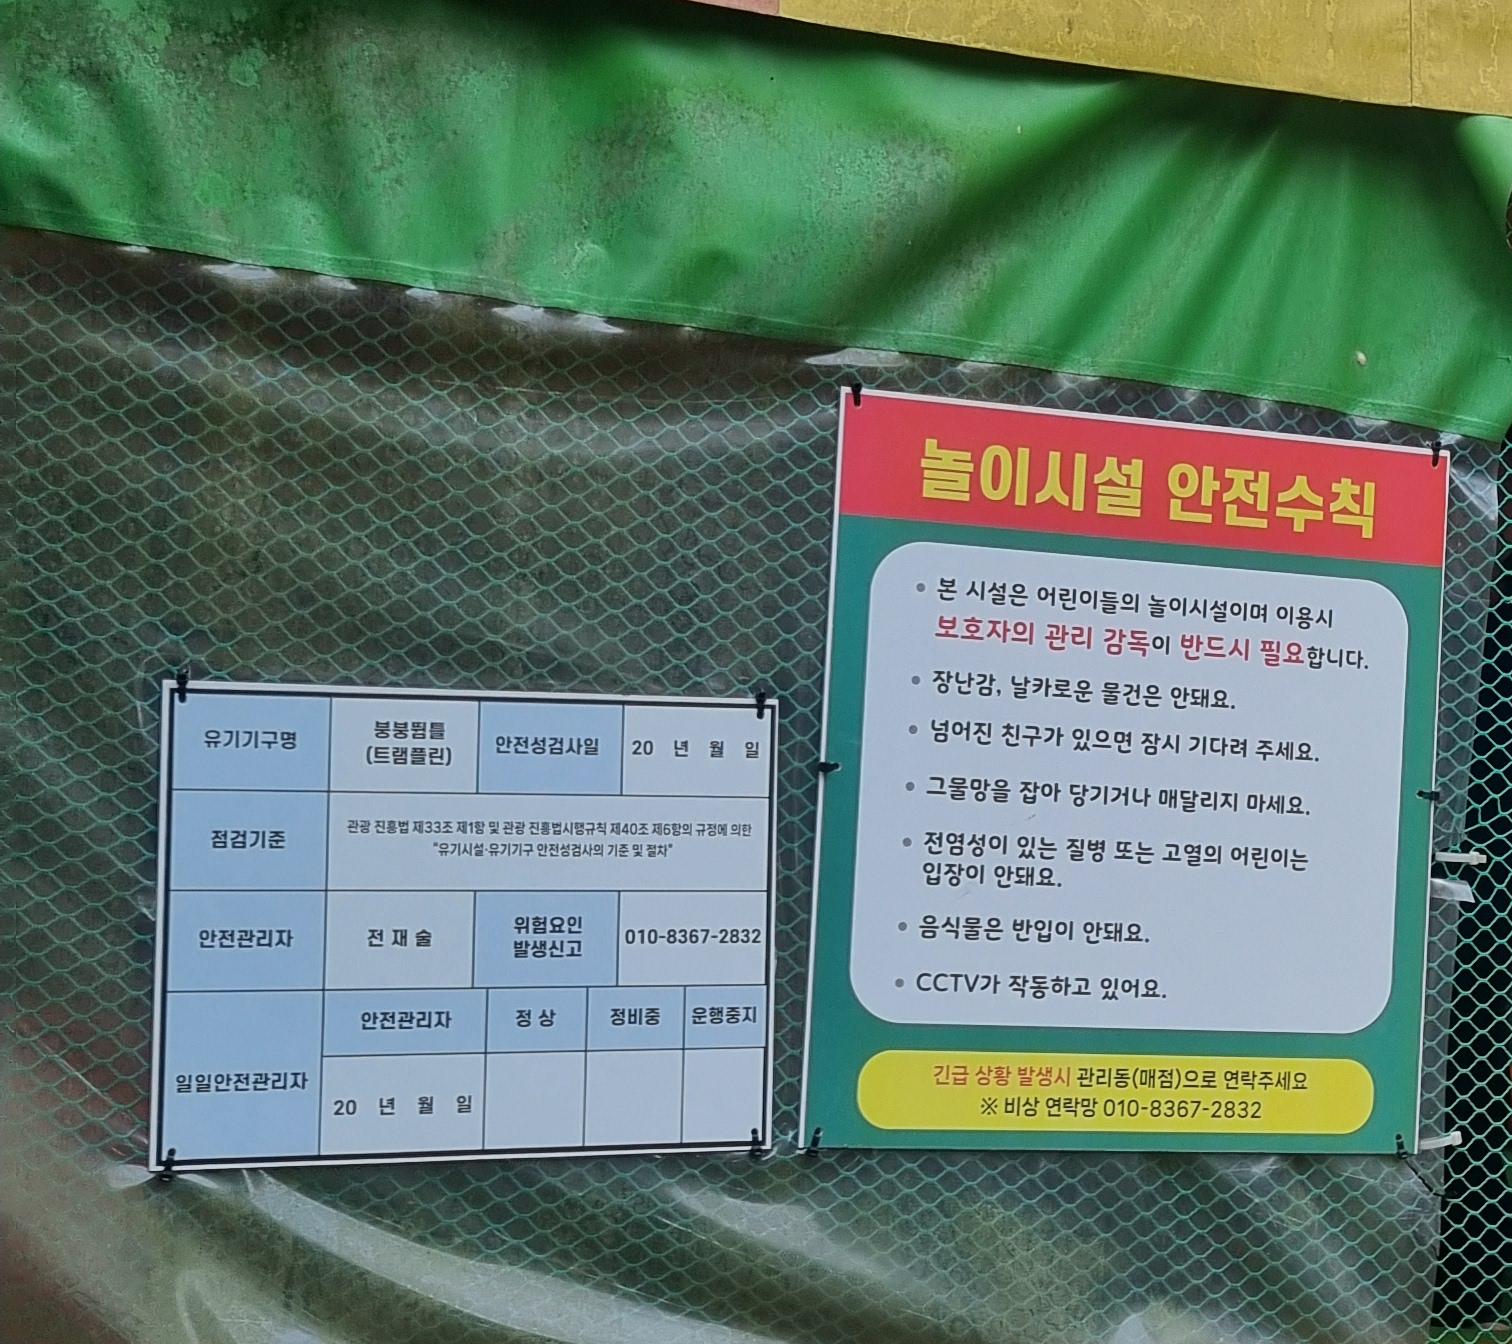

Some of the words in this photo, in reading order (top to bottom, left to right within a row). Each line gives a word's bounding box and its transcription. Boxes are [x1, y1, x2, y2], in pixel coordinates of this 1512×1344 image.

[920, 438, 1144, 518] 놀이시설
[1167, 463, 1376, 539] 안전수칙
[936, 577, 958, 602] 본
[965, 580, 1029, 607] 시설은
[1037, 586, 1140, 615] 어린이들의
[1147, 594, 1268, 624] 놀이시설이며
[1276, 605, 1333, 630] 이용시
[934, 615, 1034, 646] 보호자의
[1044, 623, 1093, 651] 관리
[1103, 628, 1171, 658] 감독이
[1180, 633, 1250, 662] 반드시
[1260, 640, 1369, 670] 필요합니다.
[932, 670, 1002, 697] 장난감,
[1010, 675, 1094, 704] 날카로운
[1101, 681, 1163, 708] 물건은
[1170, 686, 1236, 710] 안돼요.
[203, 729, 297, 750] 유기기구명
[495, 735, 599, 756] 안전성검사일
[631, 739, 654, 756] 20
[673, 739, 689, 758] 년
[709, 740, 724, 759] 월
[744, 741, 760, 759] 일
[930, 719, 992, 746] 넘어진
[1001, 722, 1065, 748] 친구가
[1071, 728, 1132, 754] 있으면
[1140, 732, 1180, 756] 잠시
[1188, 735, 1248, 758] 기다려
[1254, 739, 1320, 762] 주세요.
[366, 745, 452, 767] (트램플린)
[925, 776, 1012, 804] 그물망을
[1019, 781, 1062, 805] 잡아
[1069, 783, 1152, 808] 당기거나
[1158, 788, 1238, 813] 매달리지
[1246, 793, 1310, 816] 마세요.
[346, 819, 371, 834] 관광
[374, 819, 410, 835] 진흥법
[412, 820, 454, 834] 제33조
[456, 820, 486, 835] 제1항
[488, 820, 500, 835] 및
[502, 820, 526, 836] 관광
[528, 821, 607, 836] 진흥법시행규칙
[609, 822, 649, 836] 제40조
[651, 822, 693, 837] 제6항의
[695, 823, 728, 837] 규정에
[730, 823, 752, 837] 의한
[211, 829, 286, 849] 점검기준
[536, 842, 604, 858] 안전성검사의
[607, 843, 630, 858] 기준
[631, 843, 643, 858] 및
[923, 831, 1008, 858] 전염성이
[1016, 835, 1058, 861] 있는
[1065, 838, 1106, 863] 질병
[1113, 840, 1155, 865] 또는
[1161, 843, 1222, 867] 고열의
[1230, 846, 1309, 872] 어린이는
[922, 862, 985, 887] 입장이
[993, 865, 1062, 889] 안돼요.
[513, 915, 582, 935] 위험요인
[918, 914, 1004, 942] 음식물은
[1012, 918, 1074, 943] 반입이
[1082, 921, 1150, 945] 안돼요.
[198, 929, 294, 949] 안전관리자
[624, 928, 762, 945] 010-8367-2832
[513, 939, 583, 959] 발생신고
[916, 972, 1001, 995] CCTV가
[1008, 975, 1092, 1000] 작동하고
[1100, 977, 1167, 1001] 있어요.
[360, 1010, 452, 1031] 안전관리자
[610, 1007, 661, 1026] 정비중
[691, 1006, 757, 1025] 운행중지
[175, 1071, 309, 1094] 일일안전관리자
[933, 1064, 970, 1086] 긴급
[975, 1065, 1012, 1087] 상황
[1017, 1065, 1071, 1087] 발생시
[1076, 1067, 1218, 1090] 관리동(매점)으로
[1223, 1069, 1308, 1091] 연락주세요
[333, 1099, 357, 1116] 20
[379, 1097, 396, 1116] 년
[417, 1095, 434, 1115] 월
[456, 1095, 472, 1114] 일
[1004, 1096, 1041, 1117] 비상
[1045, 1096, 1099, 1118] 연락망
[1103, 1098, 1262, 1119] 010-8367-2832
